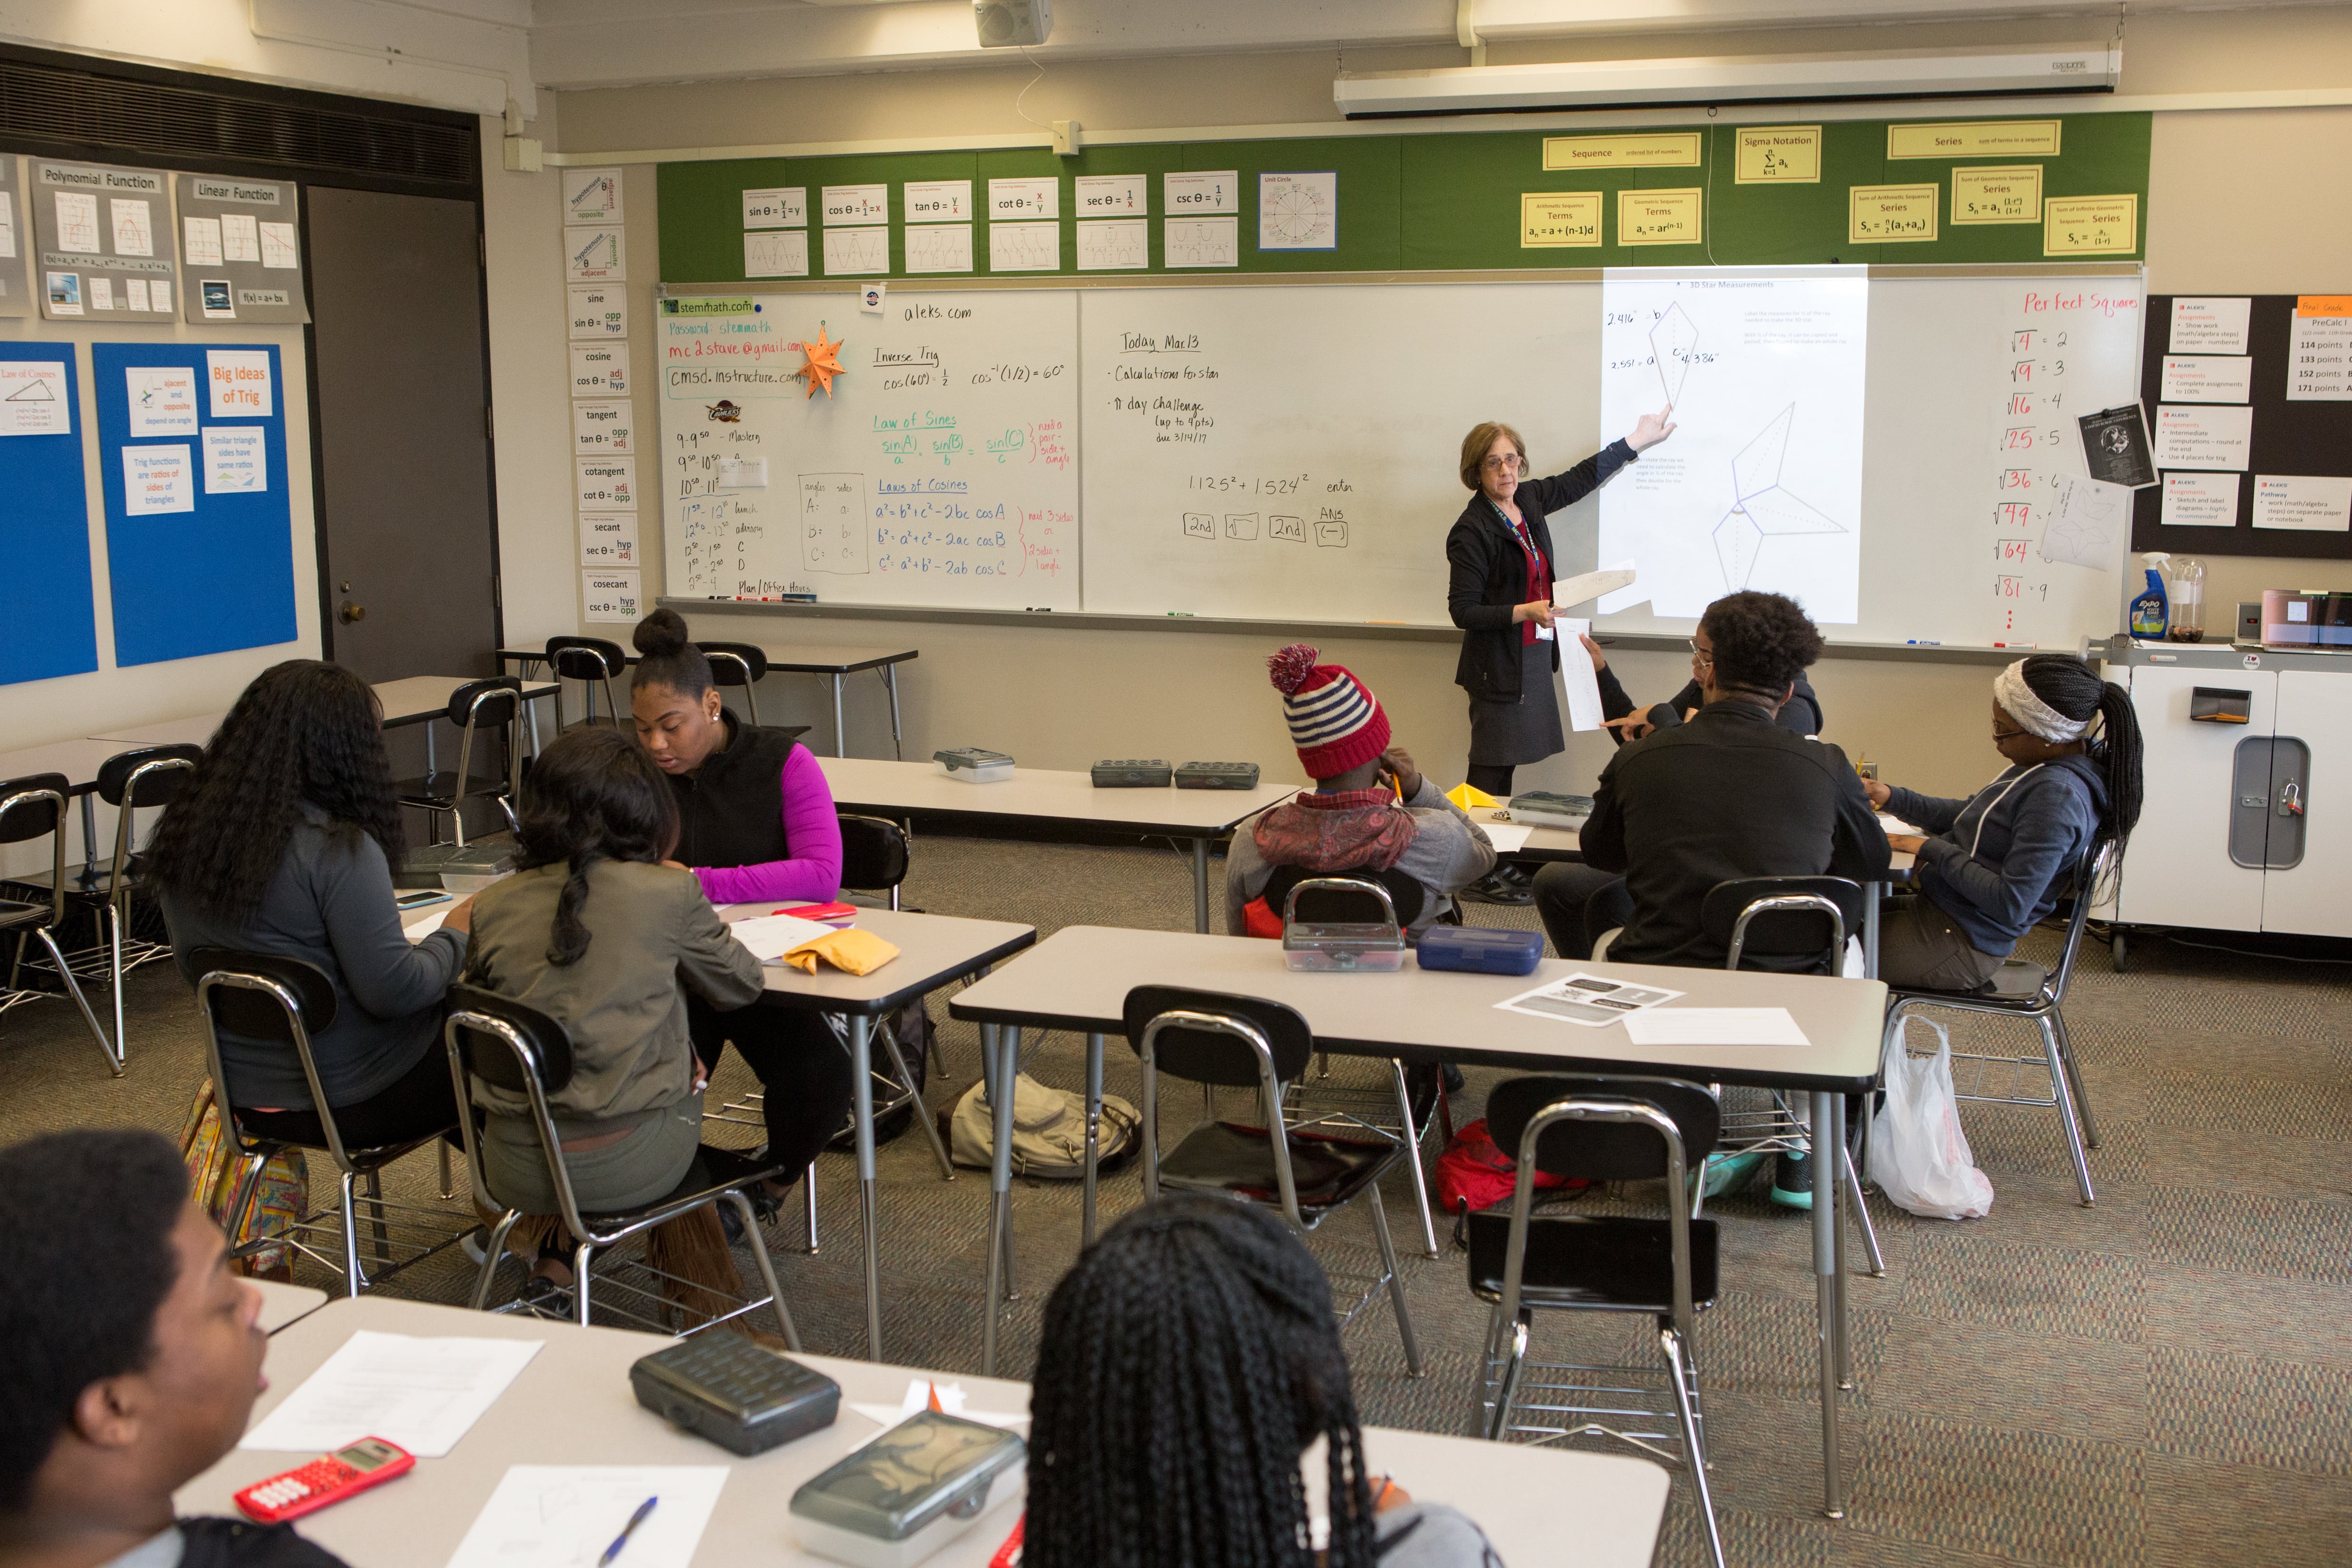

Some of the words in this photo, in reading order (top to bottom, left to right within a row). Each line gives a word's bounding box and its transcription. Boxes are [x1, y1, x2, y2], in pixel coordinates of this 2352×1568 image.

[1745, 137, 1770, 146] Sigma
[1773, 136, 1812, 145] Notation
[1935, 137, 1962, 145] Series
[1572, 148, 1612, 159] Sequence
[46, 170, 101, 185] Polynomial
[107, 174, 155, 189] Function
[199, 184, 229, 197] Linear
[234, 187, 274, 201] Function
[571, 176, 602, 205] hypotenuse
[1983, 184, 2010, 193] Series
[1880, 203, 1907, 212] Series
[578, 210, 604, 219] opposite
[2092, 214, 2121, 223] Series
[574, 233, 604, 262] hypotenuse
[588, 295, 604, 303] sine
[680, 301, 752, 313] stemmath.com
[2091, 294, 2138, 317] Squares
[2303, 303, 2318, 311] Final
[669, 322, 713, 334] Password:
[719, 321, 773, 333] stemmath
[1121, 333, 1155, 351] Today
[586, 353, 611, 361] cosine
[873, 347, 913, 364] Inverse
[917, 346, 939, 367] Trig
[1, 369, 17, 378] Law
[19, 369, 27, 378] of
[29, 370, 56, 378] Cosines
[214, 367, 232, 383] Big
[235, 367, 265, 380] Ideas
[1116, 366, 1178, 380] Calculations
[164, 379, 187, 388] ajacent
[223, 390, 235, 403] of
[237, 390, 260, 406] Trig
[164, 403, 190, 411] opposite
[1128, 398, 1147, 414] day
[1153, 397, 1204, 418] challenge
[586, 411, 617, 421] tangent
[709, 407, 741, 420] CAVALIERS
[145, 417, 167, 425] depend
[178, 417, 191, 426] angle
[873, 415, 898, 428] Law
[903, 412, 917, 428] of
[926, 411, 957, 426] Sines
[1175, 417, 1184, 426] to
[210, 436, 232, 444] Similar
[233, 436, 257, 446] triangle
[729, 432, 760, 443] Mastery
[1157, 434, 1170, 442] due
[1175, 433, 1206, 444] 3/14/17
[219, 449, 234, 457] sides
[236, 449, 251, 457] have
[134, 458, 147, 468] Trig
[149, 457, 180, 467] functions
[234, 460, 253, 469] ratios
[151, 469, 170, 478] ratios
[172, 469, 179, 478] of
[585, 468, 624, 477] cotangent
[146, 482, 163, 492] sides
[165, 482, 172, 491] of
[837, 484, 852, 492] sides
[879, 479, 907, 492] Laws
[910, 479, 922, 492] of
[927, 479, 968, 491] Cosines
[145, 494, 174, 505] triangles
[735, 502, 758, 514] lunch
[1321, 508, 1343, 519] ANS
[1190, 518, 1211, 532] 2nd
[1275, 520, 1300, 536] 2nd
[736, 526, 763, 538] advisory
[2139, 600, 2160, 608] EXPO
